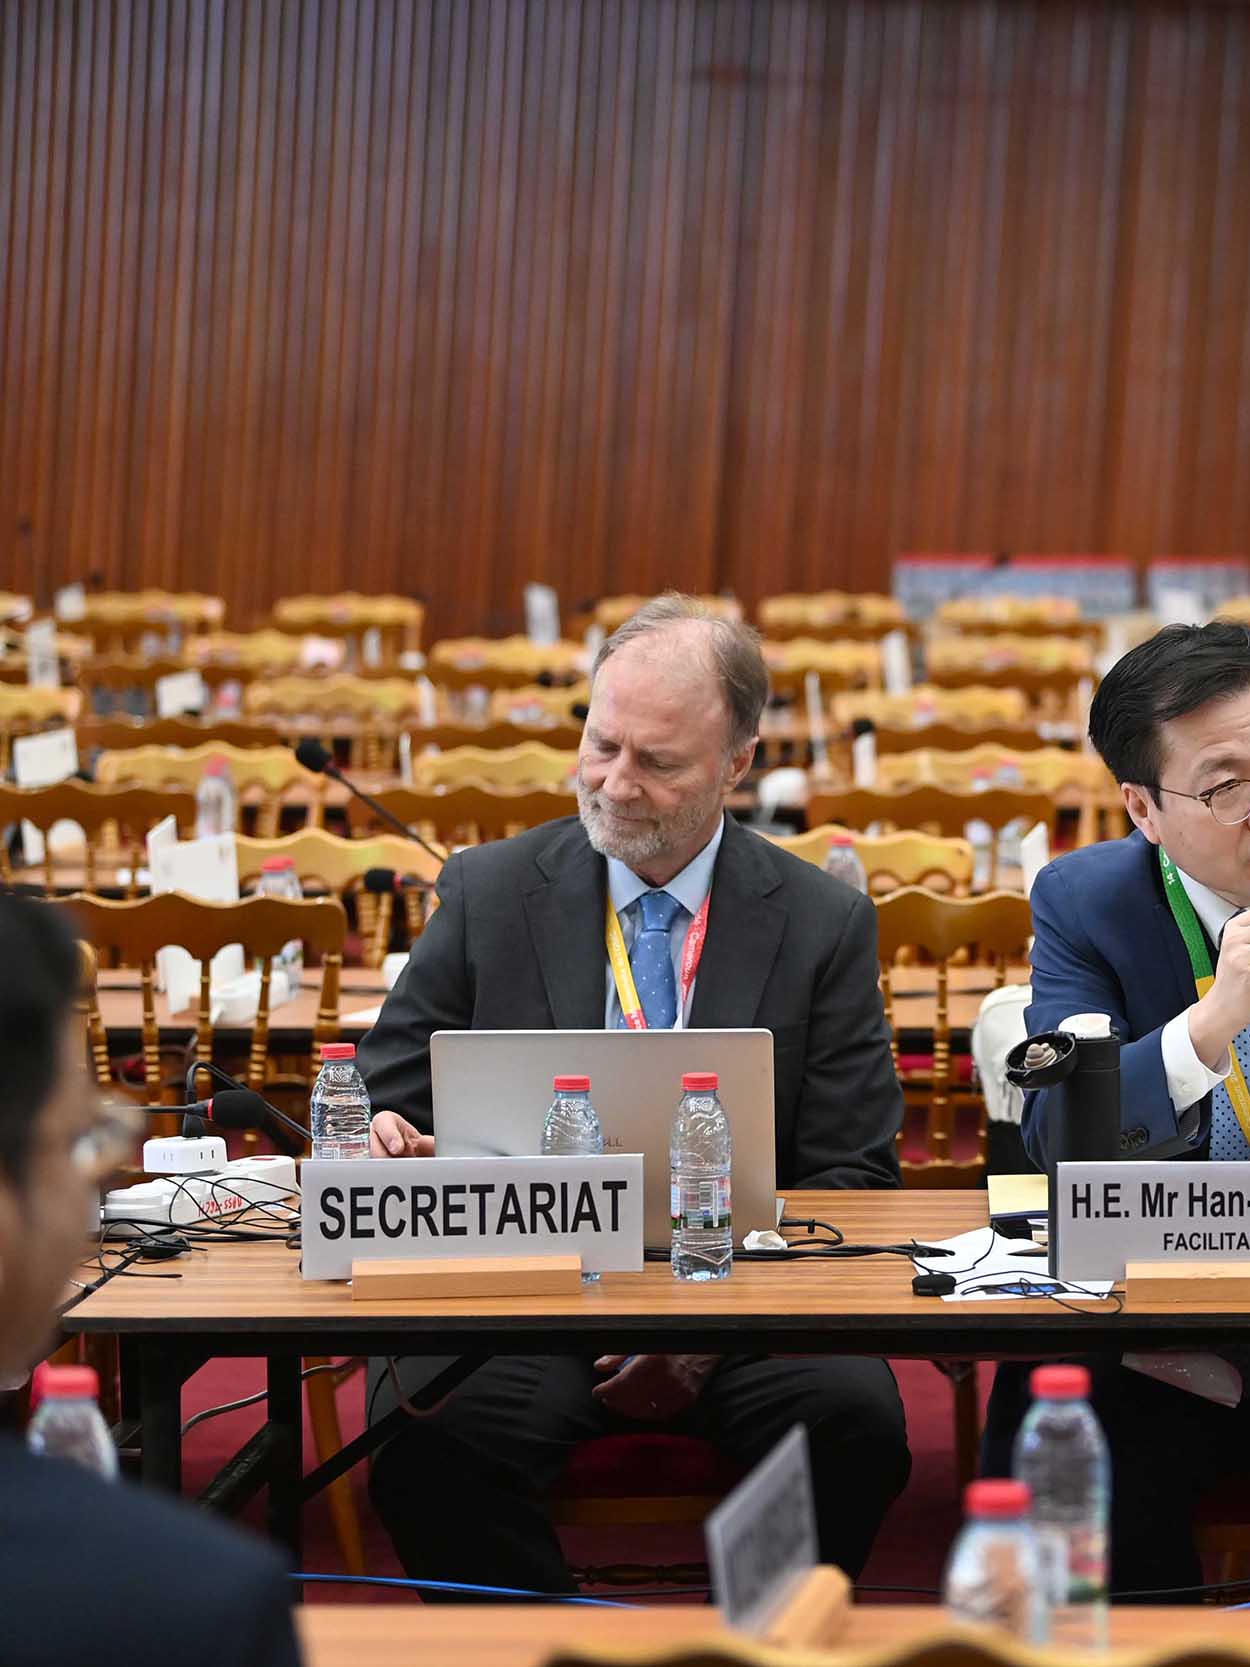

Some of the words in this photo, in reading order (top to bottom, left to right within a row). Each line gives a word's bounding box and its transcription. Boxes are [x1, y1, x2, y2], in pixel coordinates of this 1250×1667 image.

[319, 1180, 628, 1240] SECRETARIAT
[1071, 1183, 1130, 1218] H.E.
[1141, 1182, 1179, 1217] Mr
